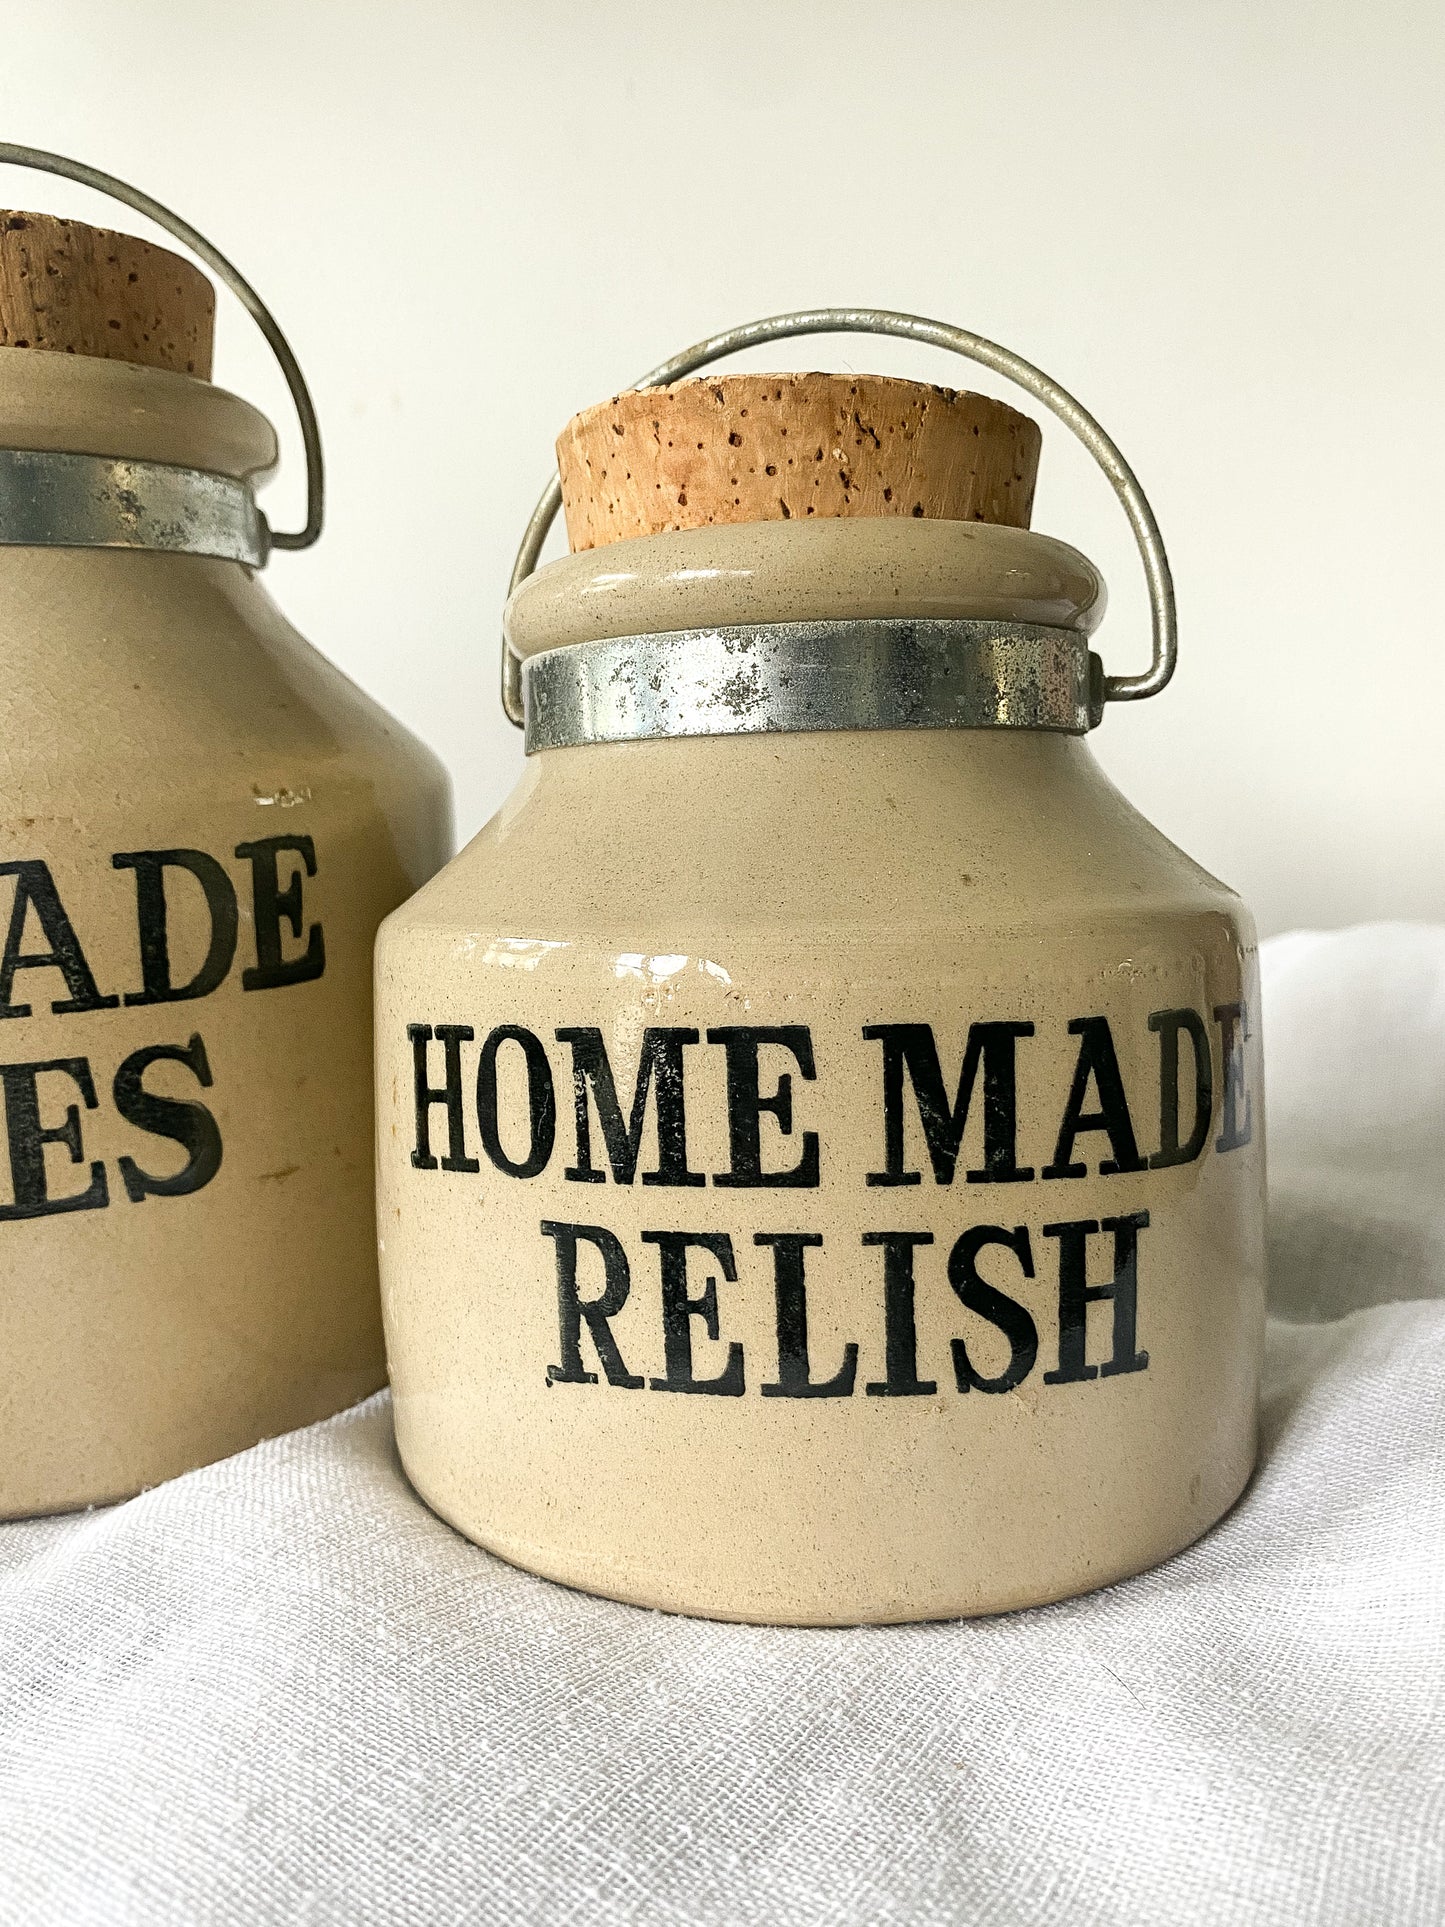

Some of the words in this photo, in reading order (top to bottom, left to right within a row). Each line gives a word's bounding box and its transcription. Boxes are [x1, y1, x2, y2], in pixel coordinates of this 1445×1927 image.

[0, 835, 326, 1019] ADE
[0, 1031, 223, 1221] ES
[406, 1023, 820, 1188] HOME
[862, 1001, 1251, 1187] MADE
[540, 1208, 1150, 1398] RELISH
